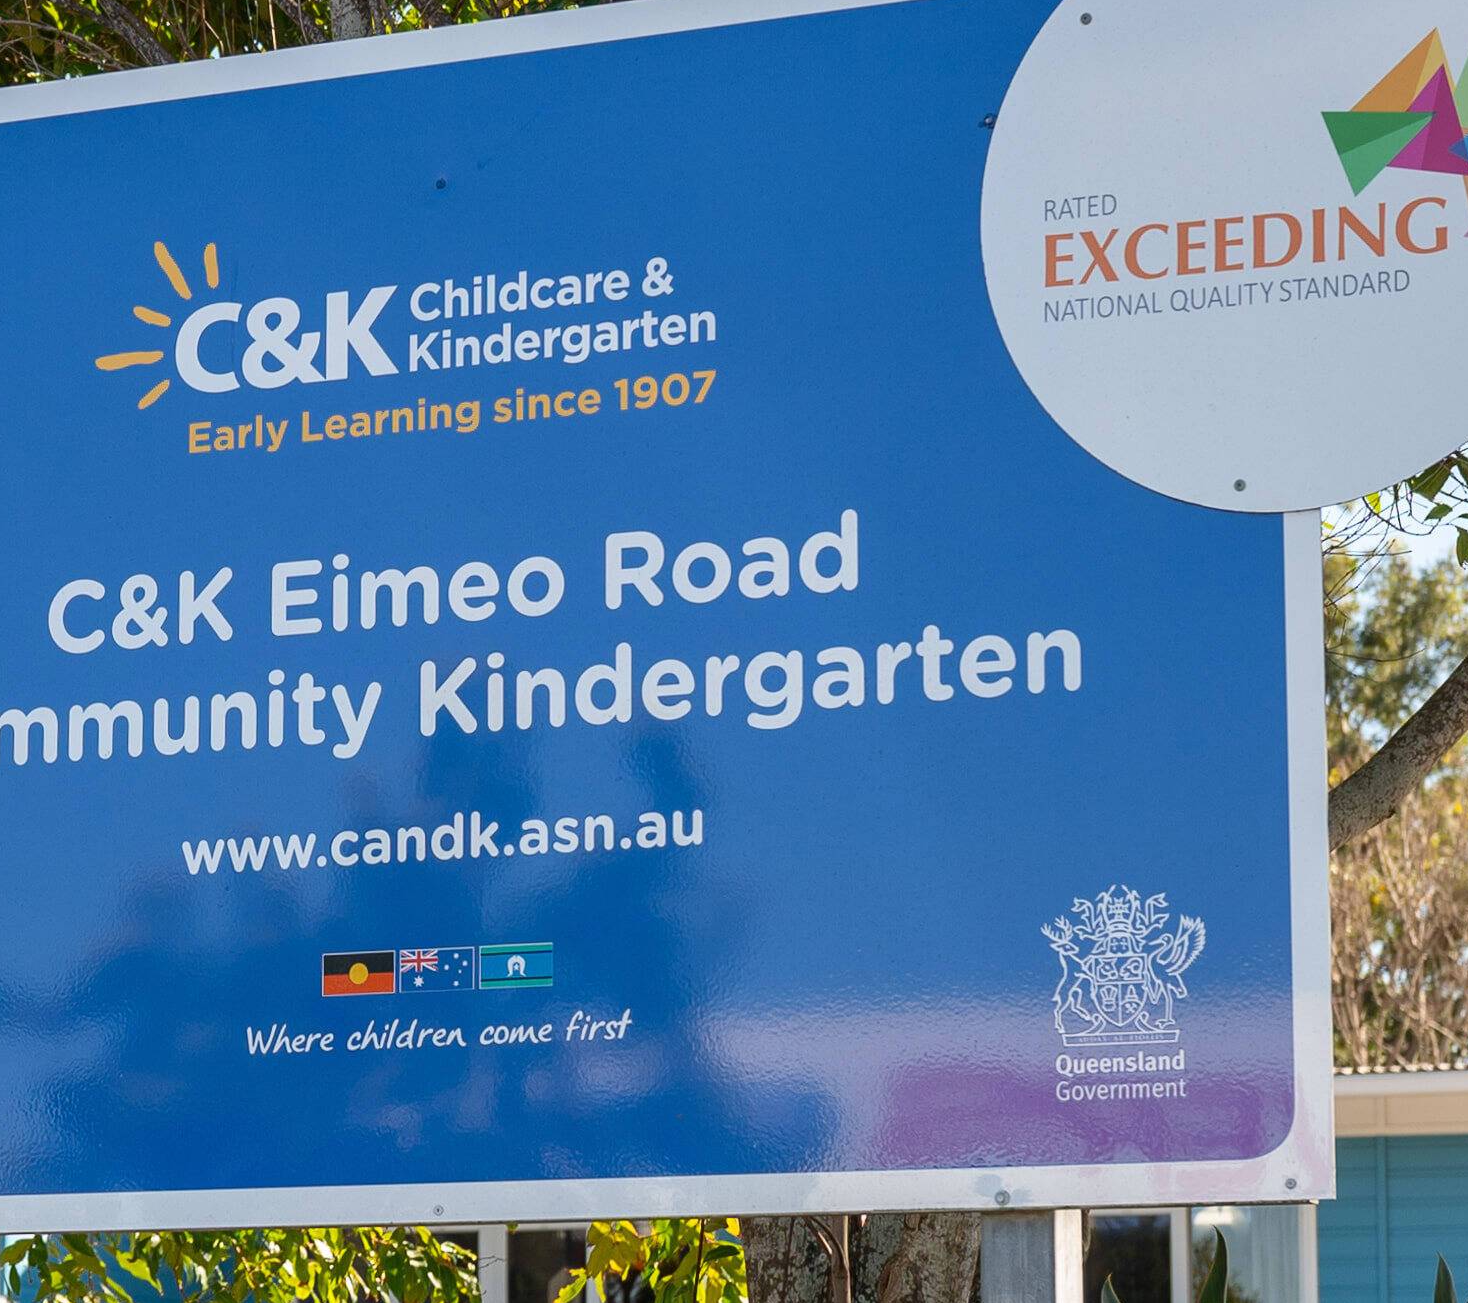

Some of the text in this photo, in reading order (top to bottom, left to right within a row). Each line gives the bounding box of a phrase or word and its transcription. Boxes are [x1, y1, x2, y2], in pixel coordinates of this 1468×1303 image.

[1044, 193, 1118, 222] RATED
[1044, 196, 1449, 288] EXCEEDING
[410, 256, 675, 322] Childcare &
[1044, 269, 1411, 323] NATIONAL QUALITY STANDARD
[175, 285, 400, 394] C&K
[409, 310, 717, 373] Kindergarten
[188, 369, 718, 454] Early Learning since 1907
[48, 508, 860, 654] C&K Eimeo Road
[419, 624, 1083, 737] Kindergarten
[181, 809, 704, 876] www.candk.asn.au
[246, 1008, 633, 1056] Where children come first
[1055, 1049, 1186, 1078] Queensland
[1056, 1078, 1187, 1101] Government
